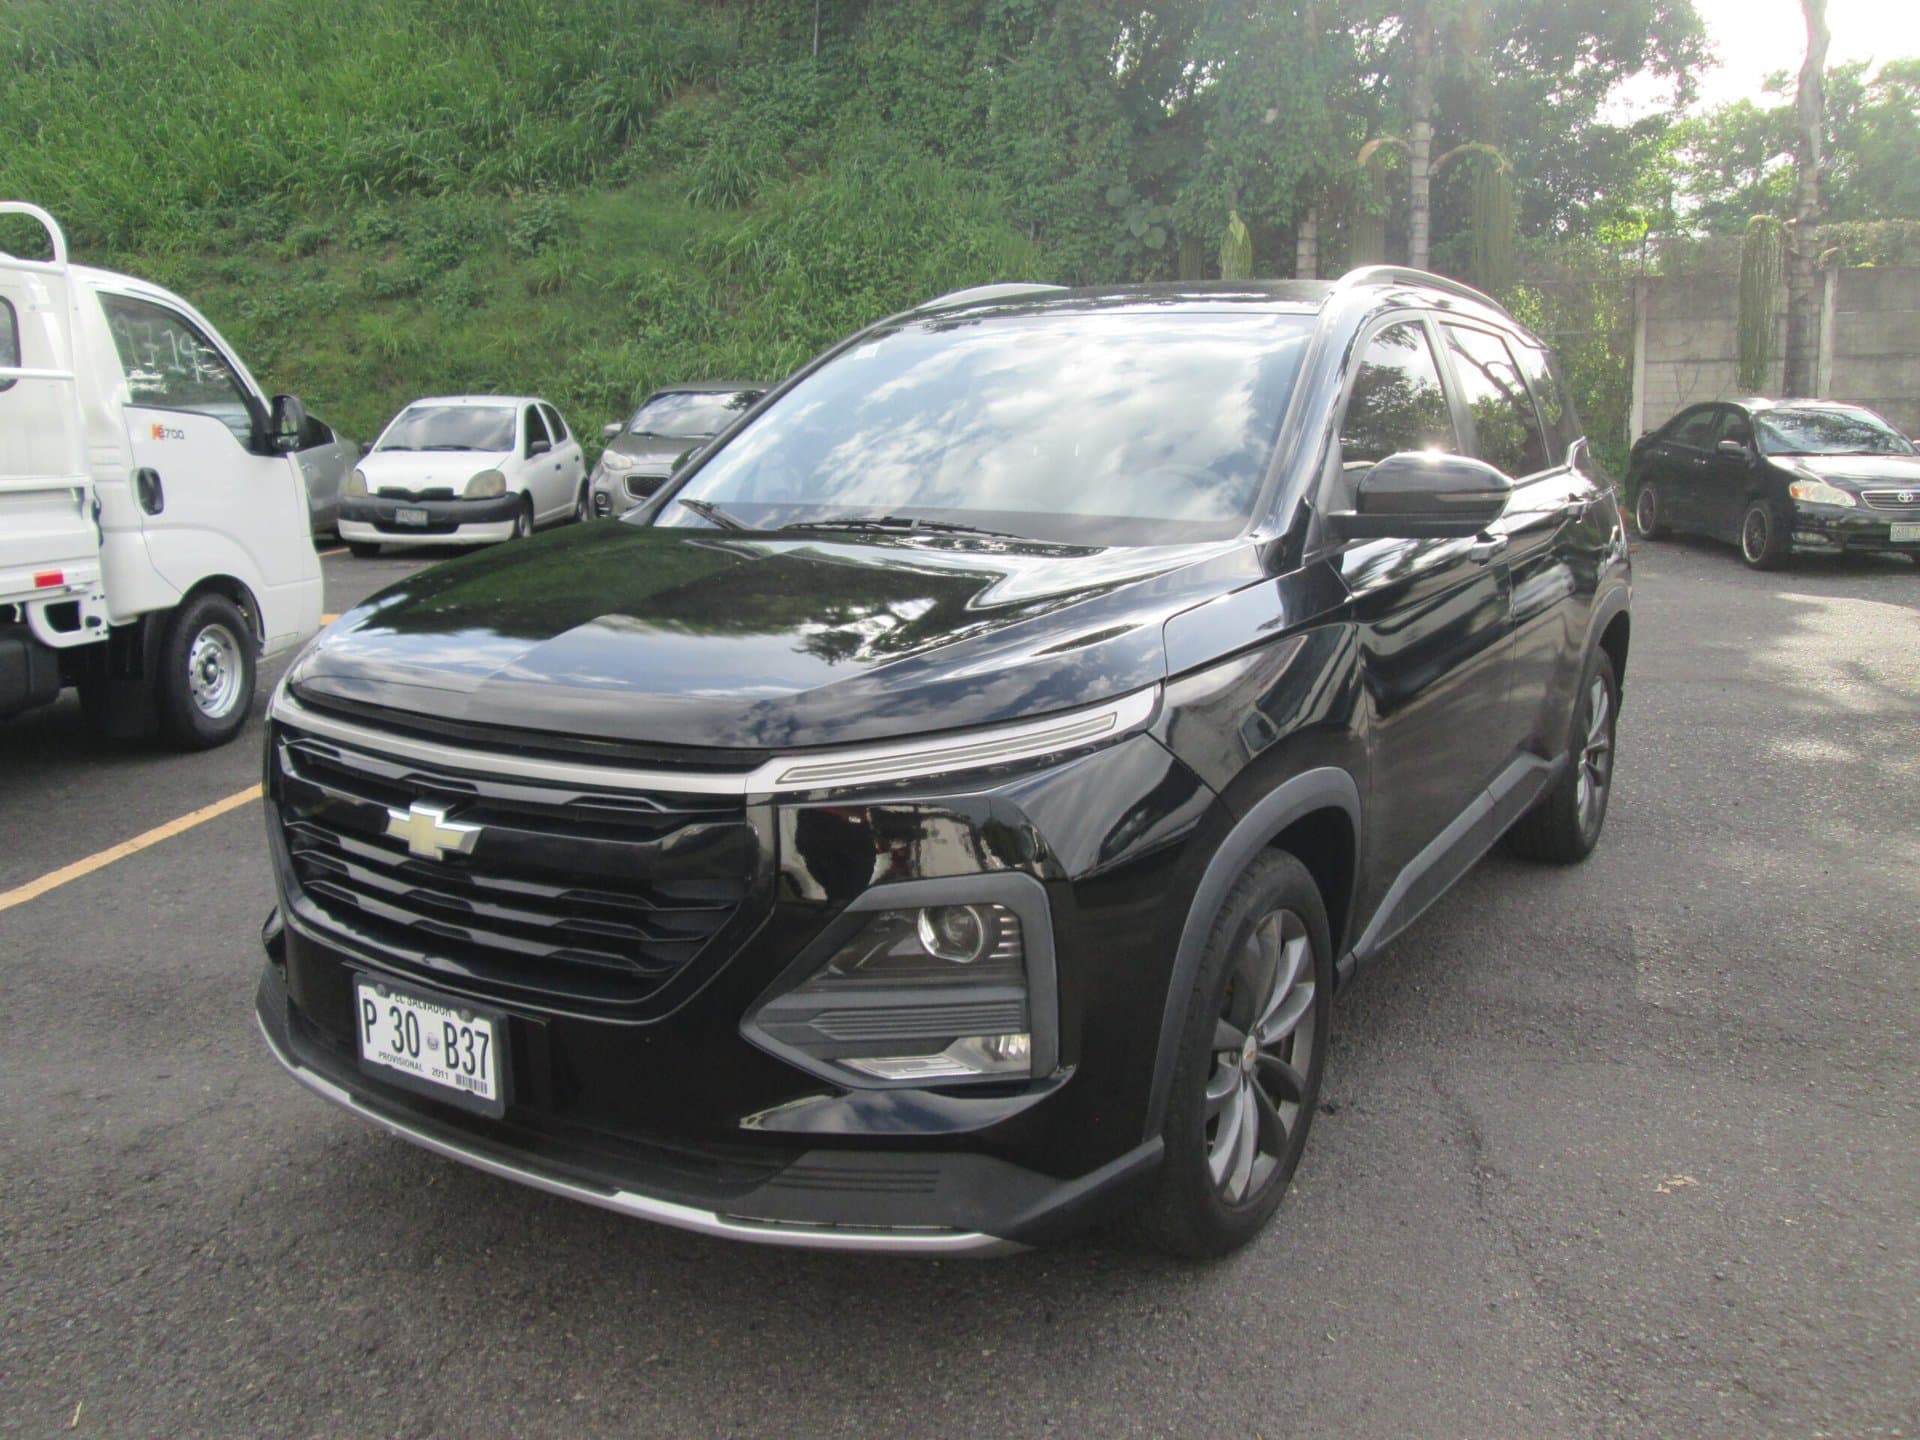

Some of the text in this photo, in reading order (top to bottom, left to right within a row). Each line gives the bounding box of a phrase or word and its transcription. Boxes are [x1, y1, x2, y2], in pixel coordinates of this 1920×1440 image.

[362, 998, 489, 1080] P 30 B37
[378, 1051, 424, 1072] PROVISIONAL
